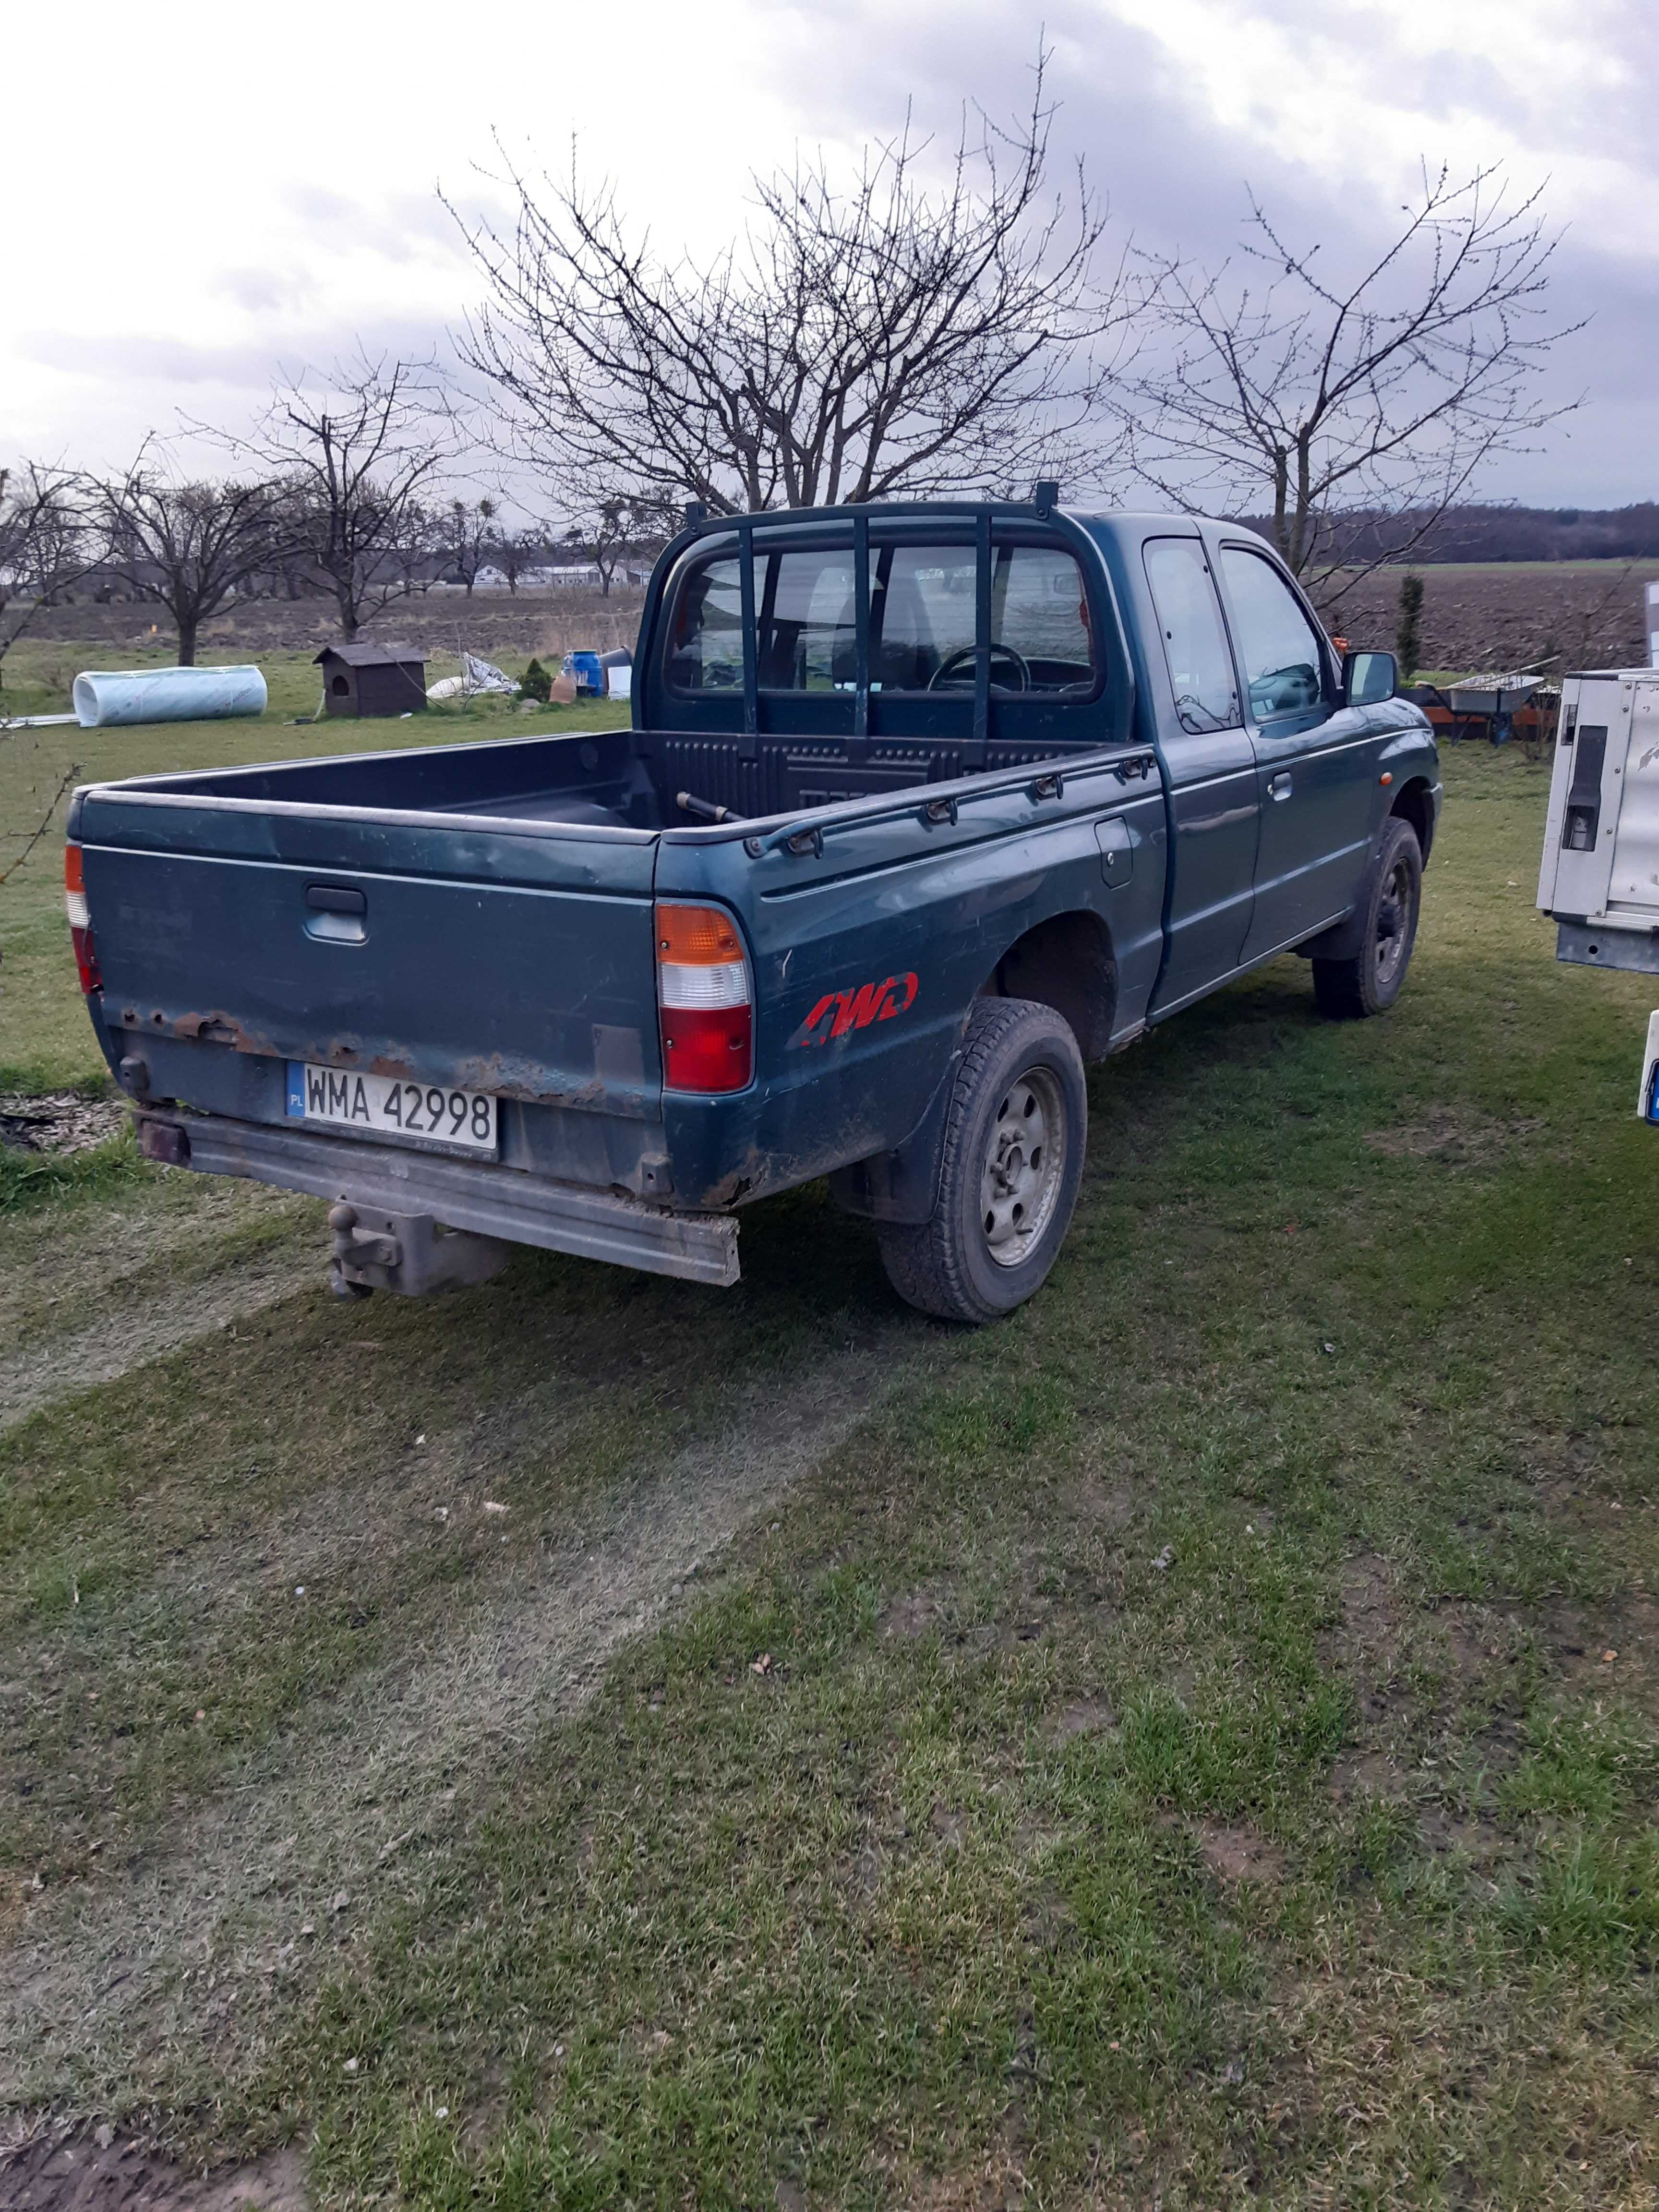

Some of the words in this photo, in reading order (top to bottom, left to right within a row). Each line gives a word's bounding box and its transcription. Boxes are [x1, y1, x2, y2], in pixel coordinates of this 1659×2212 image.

[291, 1094, 303, 1107] PL
[308, 1069, 371, 1121] WMA
[384, 1083, 490, 1140] 42998
